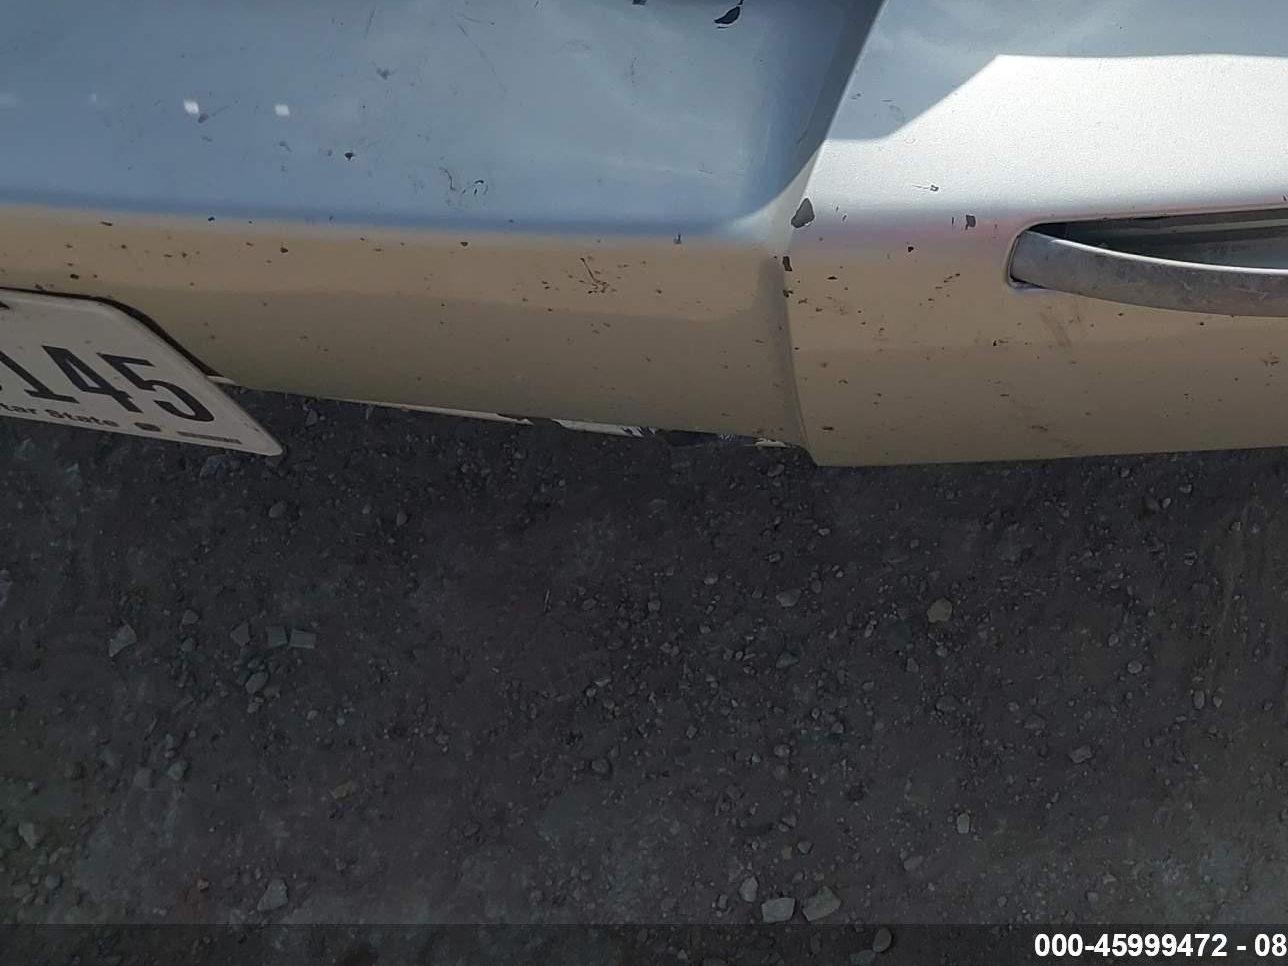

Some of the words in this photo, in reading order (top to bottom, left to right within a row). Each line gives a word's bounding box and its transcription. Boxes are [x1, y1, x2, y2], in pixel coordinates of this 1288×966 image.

[0, 345, 215, 422] 145
[0, 402, 37, 414] tar
[45, 409, 120, 427] State
